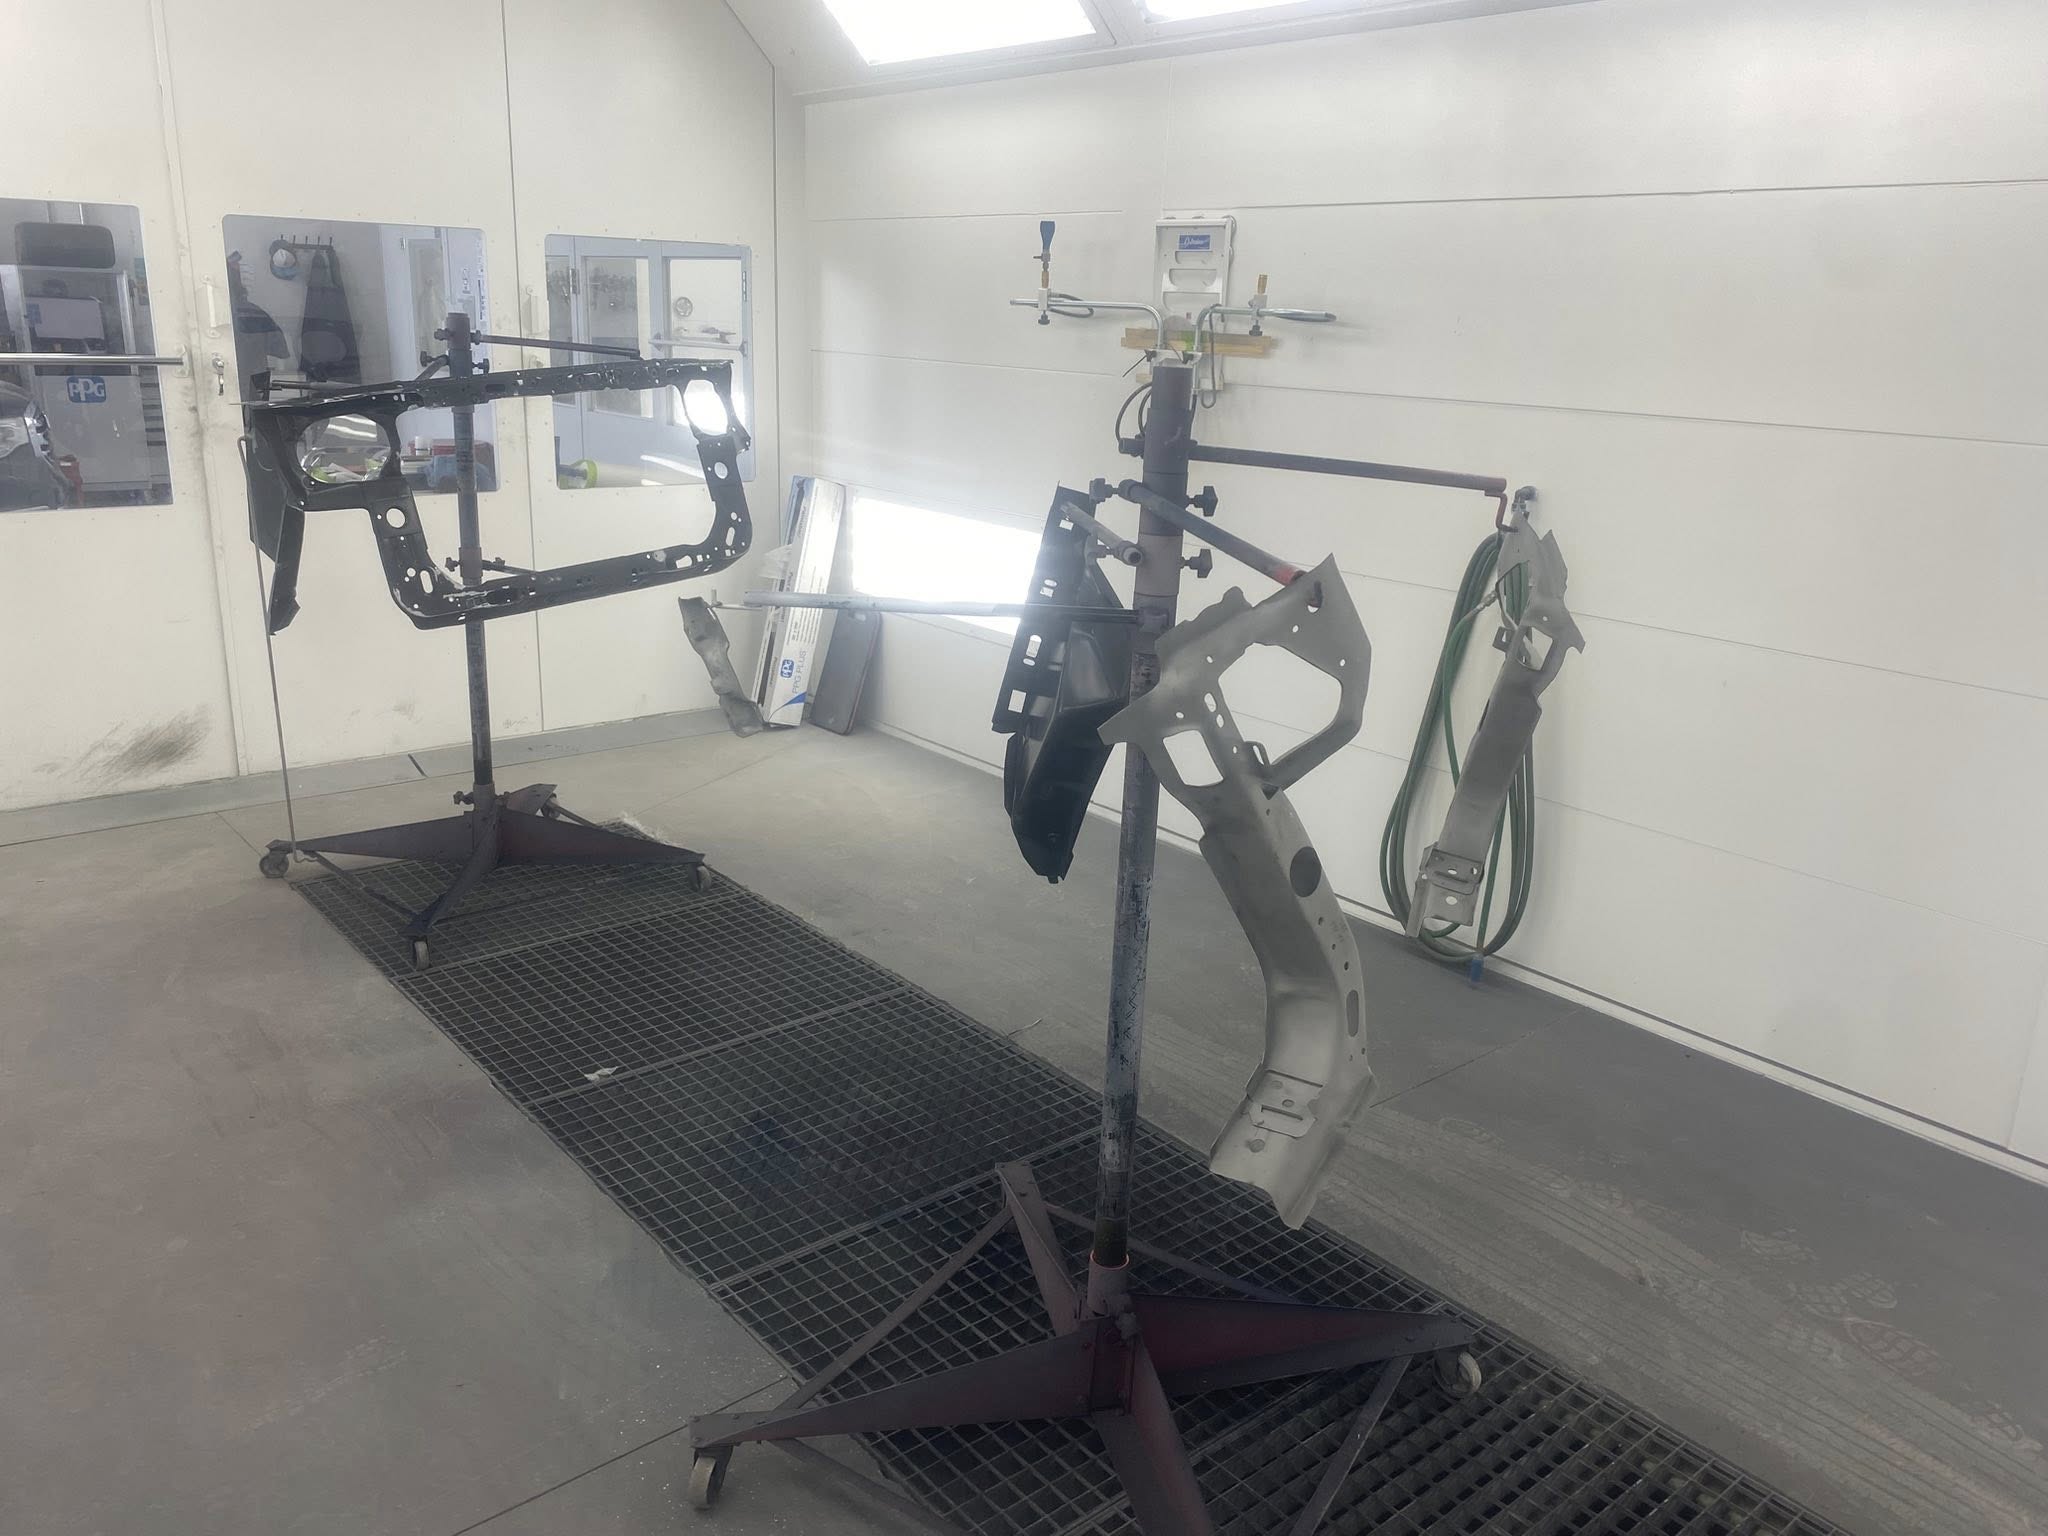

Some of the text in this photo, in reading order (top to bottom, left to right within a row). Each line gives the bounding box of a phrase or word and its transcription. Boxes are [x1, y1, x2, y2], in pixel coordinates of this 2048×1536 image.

[68, 377, 105, 402] PPG
[792, 651, 807, 694] PPG PLUS
